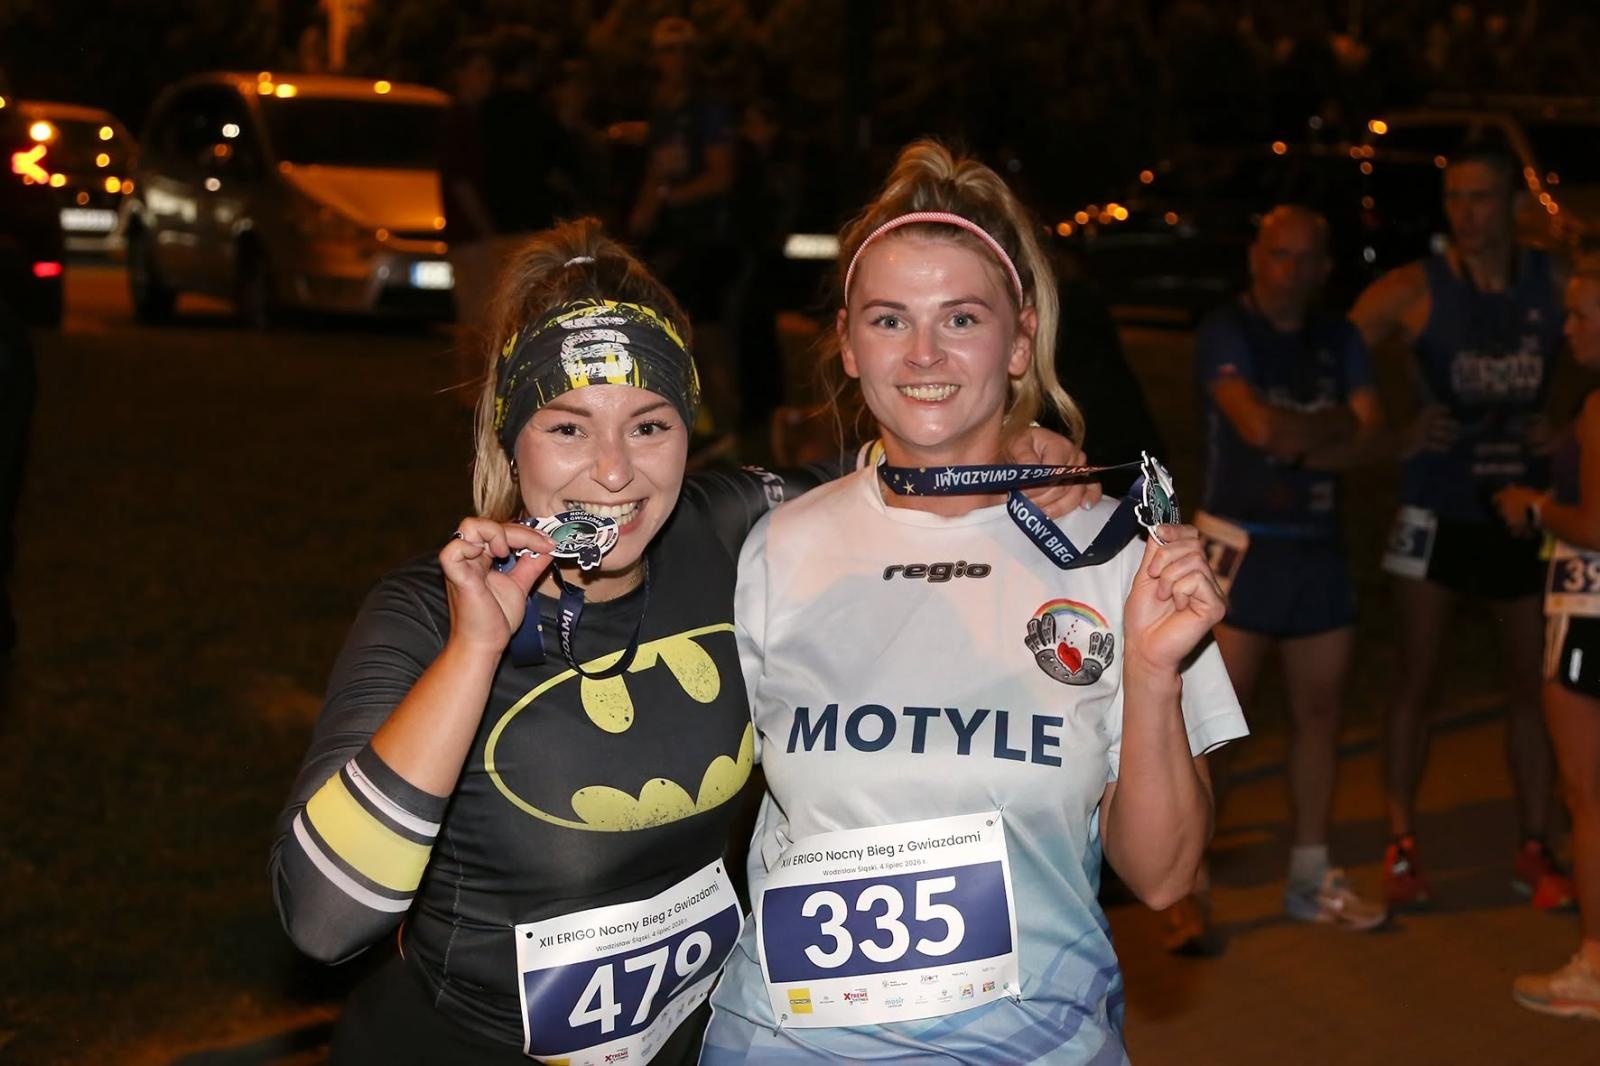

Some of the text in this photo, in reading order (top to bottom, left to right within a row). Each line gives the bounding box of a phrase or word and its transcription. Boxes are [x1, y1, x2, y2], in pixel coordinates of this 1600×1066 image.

[935, 468, 1018, 488] GWIAZDAMI
[1010, 499, 1074, 563] NOCNY BIEG
[883, 560, 992, 583] regio
[786, 704, 1064, 767] MOTYLE
[793, 852, 823, 866] ERIGO
[826, 848, 863, 861] Nocny
[867, 844, 895, 857] Bieg
[898, 844, 904, 853] z
[907, 831, 981, 851] Gwiazdami
[539, 880, 720, 949] XII ERIGO Nocny Bieg z Gwiazdami
[801, 876, 965, 968] 335
[568, 931, 712, 1034] 479
